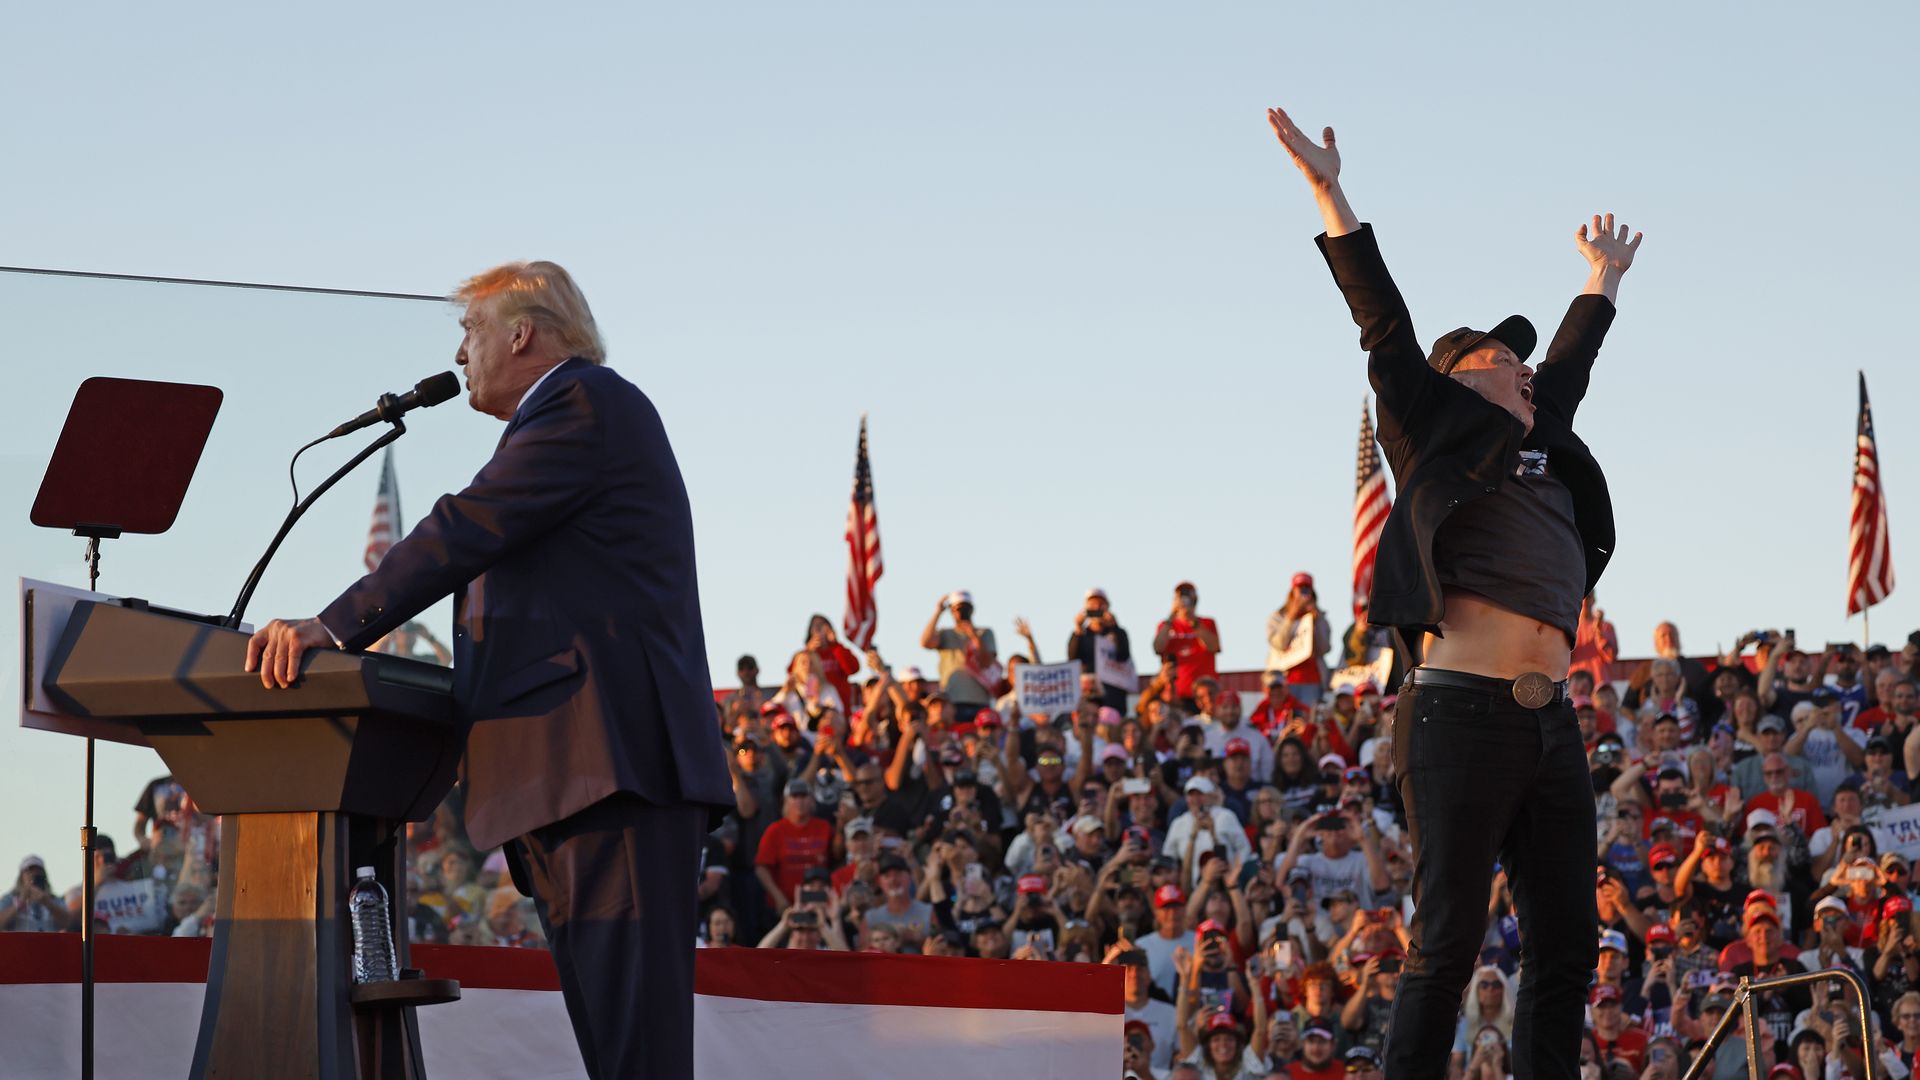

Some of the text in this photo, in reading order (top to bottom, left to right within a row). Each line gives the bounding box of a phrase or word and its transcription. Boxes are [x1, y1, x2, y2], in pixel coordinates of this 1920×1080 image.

[1023, 668, 1073, 681] FIGHT!
[1023, 680, 1074, 694] FIGHT!
[1024, 693, 1074, 706] FIGHT!
[97, 892, 148, 910] RUMP
